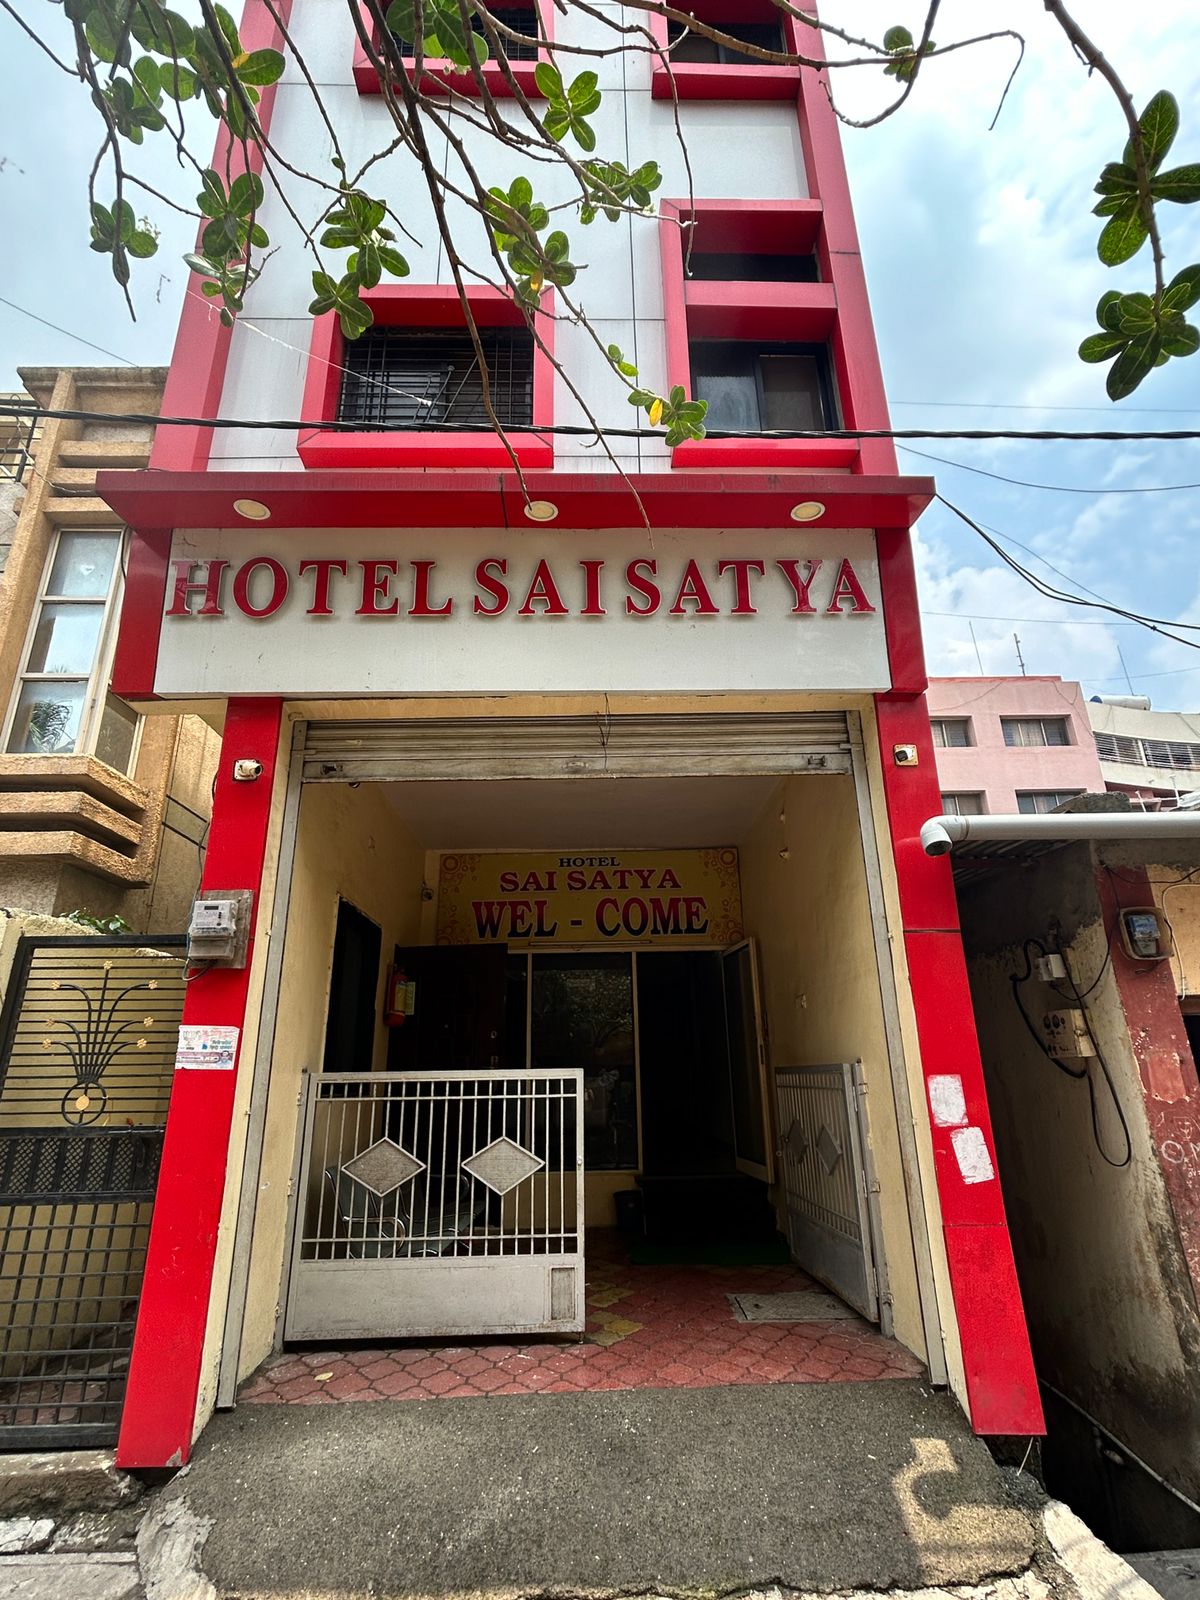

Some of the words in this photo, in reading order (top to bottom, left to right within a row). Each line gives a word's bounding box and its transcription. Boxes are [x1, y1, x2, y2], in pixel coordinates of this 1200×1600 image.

[165, 557, 453, 618] HOTEL
[473, 558, 607, 616] SAI
[625, 558, 876, 615] SATYA
[558, 857, 620, 868] HOTEL
[500, 870, 557, 892] SAI
[567, 868, 682, 891] SATYA
[471, 899, 558, 939] WEL
[595, 896, 709, 937] COME
